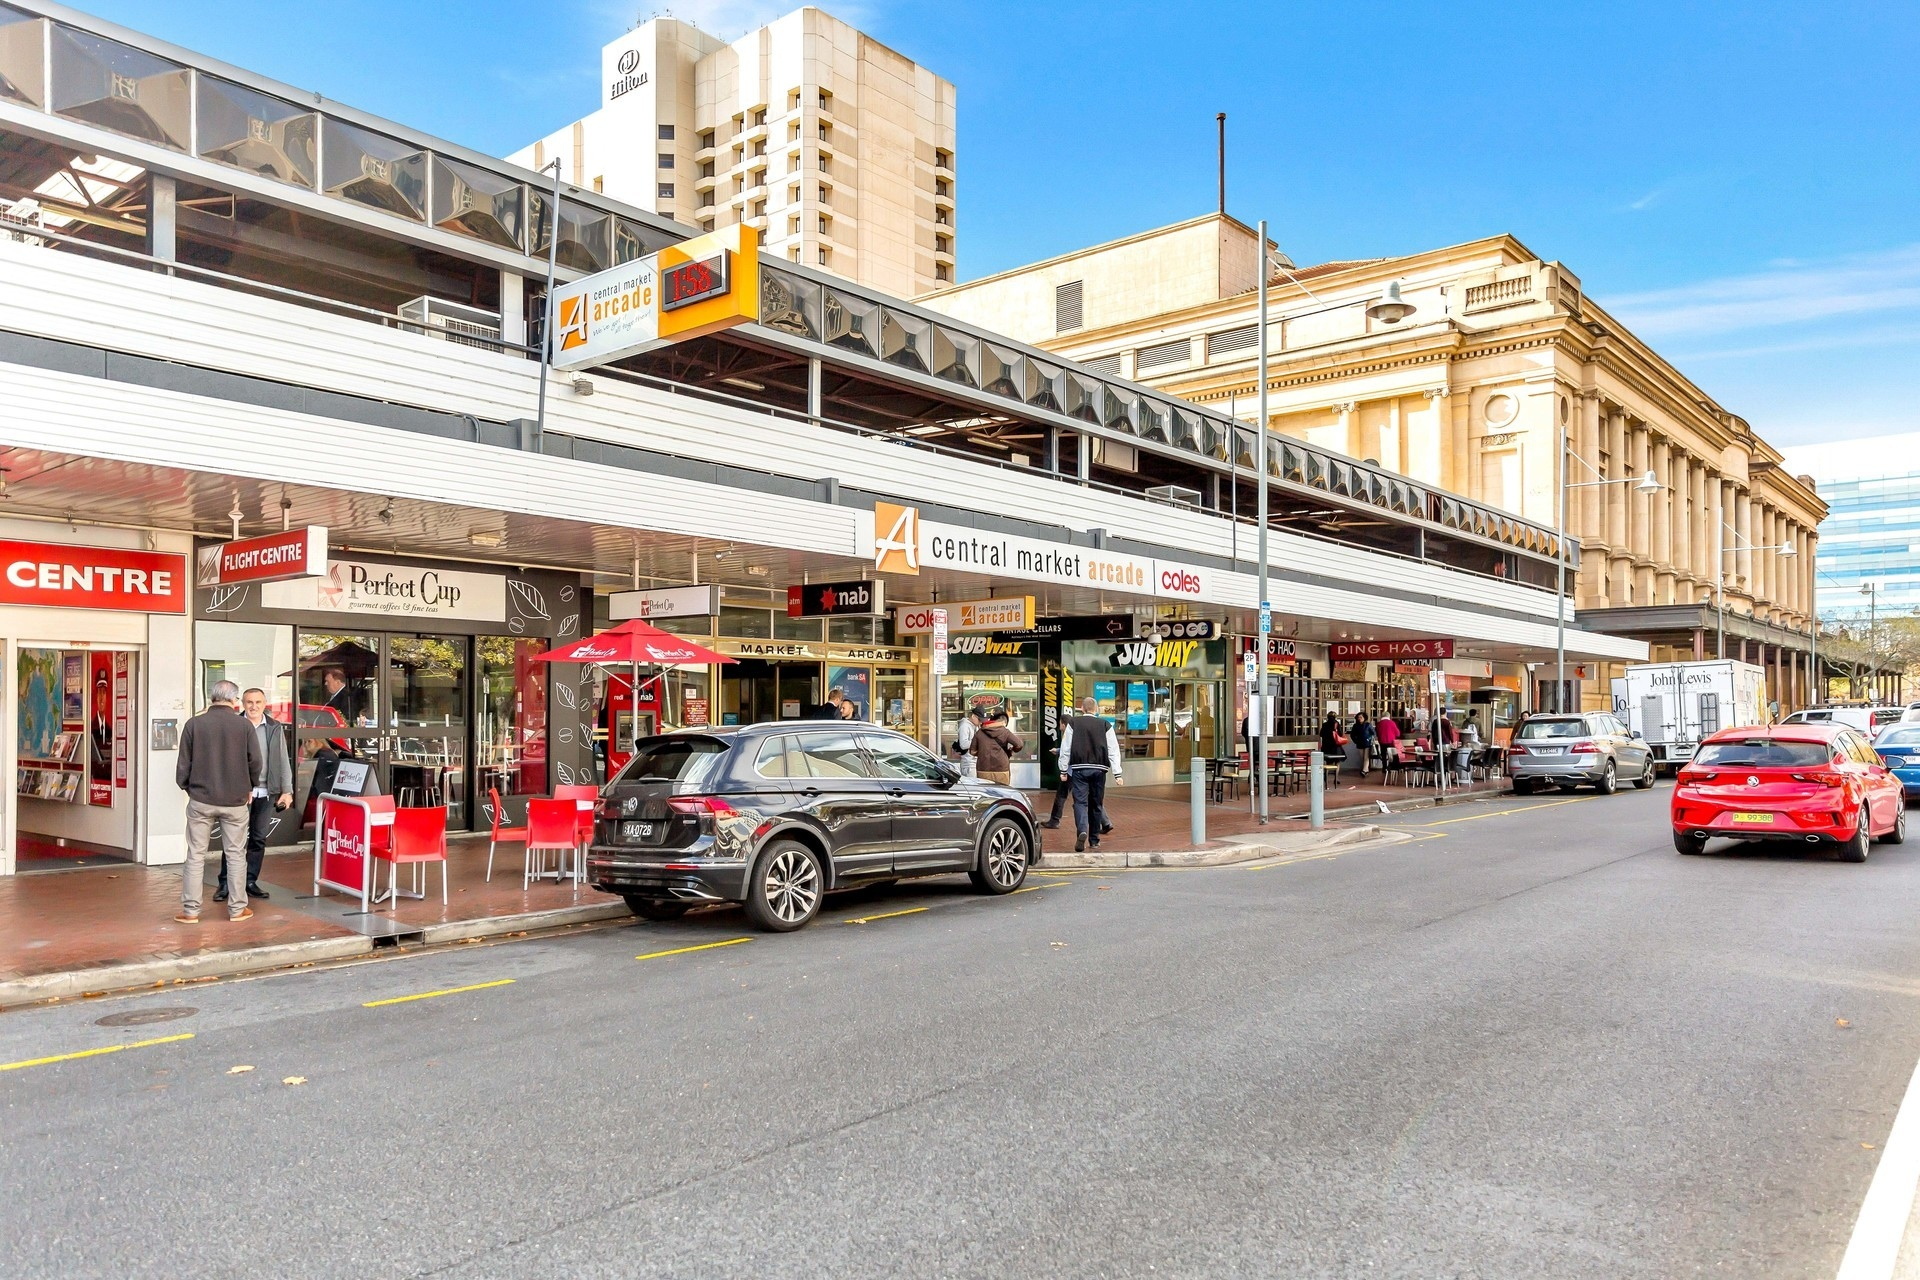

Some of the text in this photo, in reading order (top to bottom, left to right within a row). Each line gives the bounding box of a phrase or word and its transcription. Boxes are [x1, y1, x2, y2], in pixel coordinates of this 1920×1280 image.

[610, 72, 648, 100] Hilton
[593, 273, 652, 300] central market
[672, 261, 712, 302] 1:58
[594, 286, 652, 321] arcade
[224, 542, 303, 572] FLIGHT CENTRE
[932, 536, 1200, 594] central market arcade coles
[6, 560, 172, 596] CENTRE
[348, 564, 461, 608] Perfect Cup
[649, 599, 664, 611] Perfect
[838, 586, 869, 606] nab
[978, 603, 1021, 613] central market
[978, 610, 1021, 625] arcade
[905, 609, 934, 629] col
[740, 644, 804, 656] MARKET
[847, 649, 901, 660] ARCADE
[948, 636, 1022, 655] SUBWAY
[1116, 640, 1198, 668] SUBWAY
[1253, 638, 1296, 656] DG HAO
[1337, 643, 1427, 655] DING HAO
[1650, 670, 1712, 687] John Lewis
[640, 692, 654, 701] nab
[971, 695, 999, 705] OPEN
[1062, 666, 1074, 717] BWAY
[1044, 666, 1058, 741] SUBWAY
[1613, 695, 1627, 713] Jo
